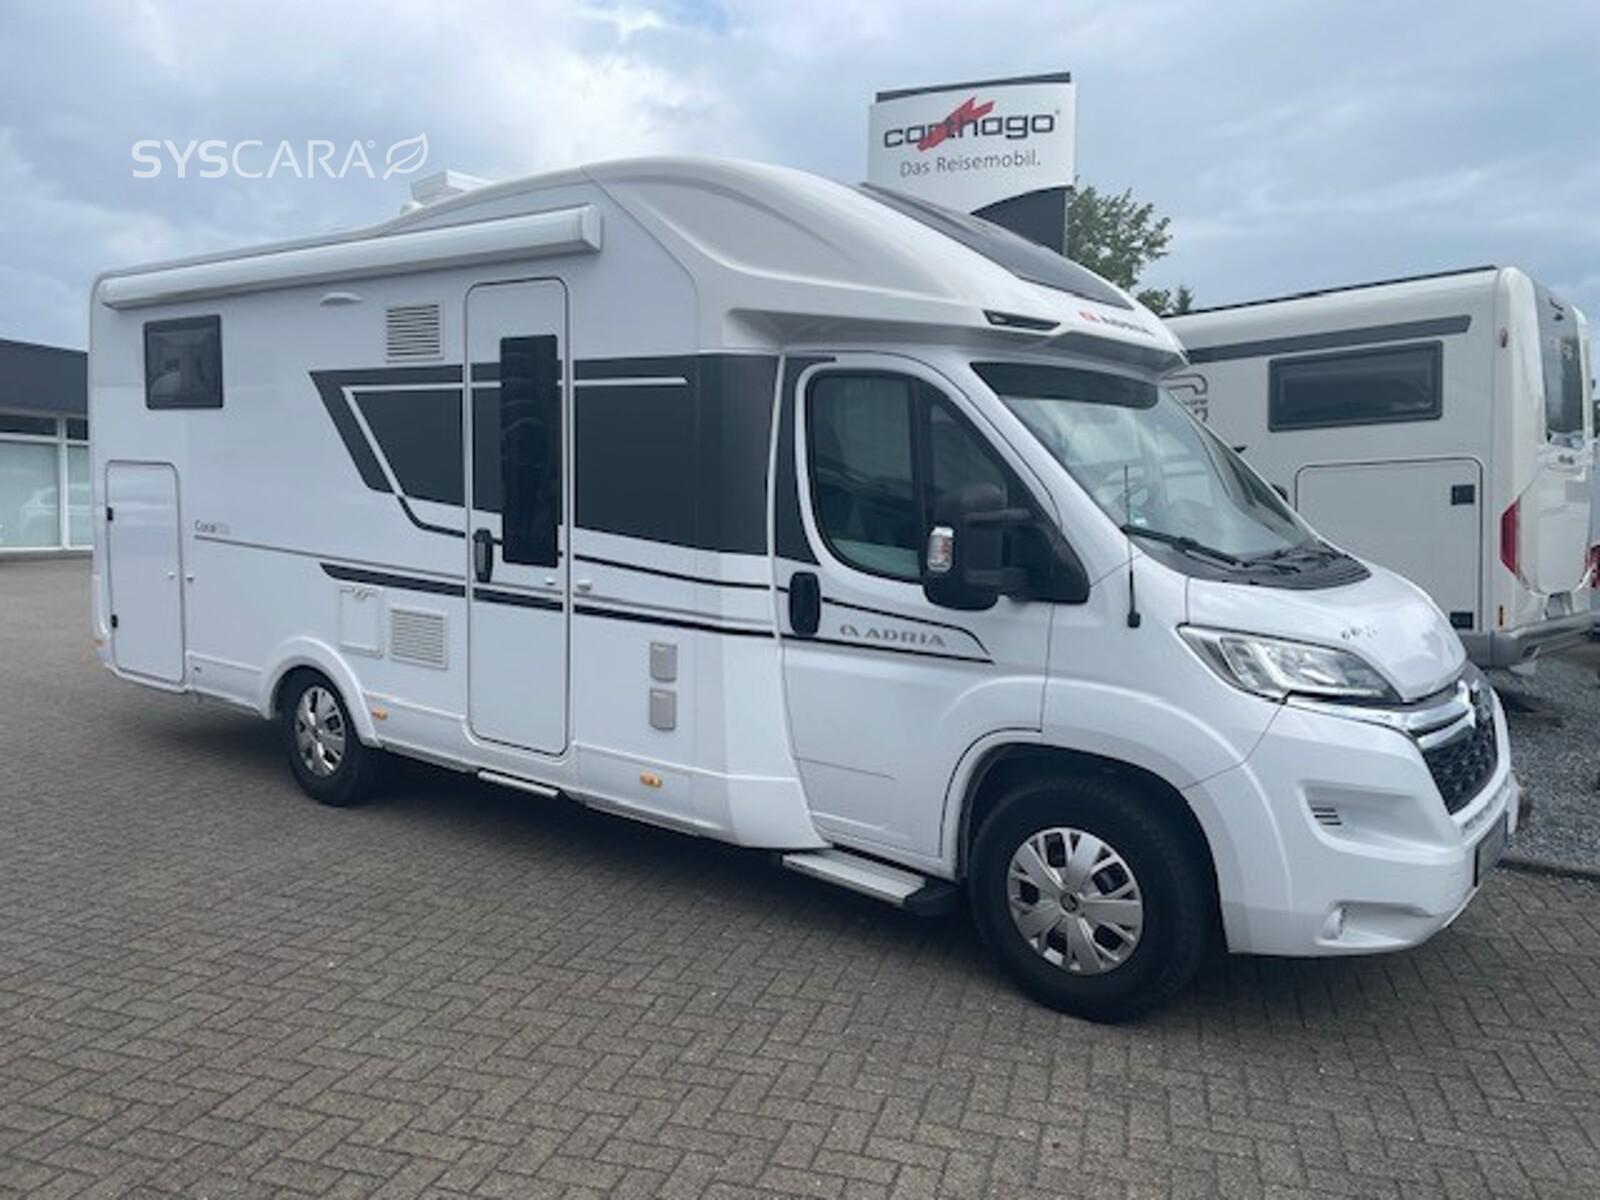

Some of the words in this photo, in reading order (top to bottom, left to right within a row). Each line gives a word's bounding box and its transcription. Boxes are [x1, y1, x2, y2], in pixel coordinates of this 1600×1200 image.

[901, 160, 930, 177] Das
[936, 149, 1041, 173] Reisemobil.
[864, 626, 946, 648] ADRIA
